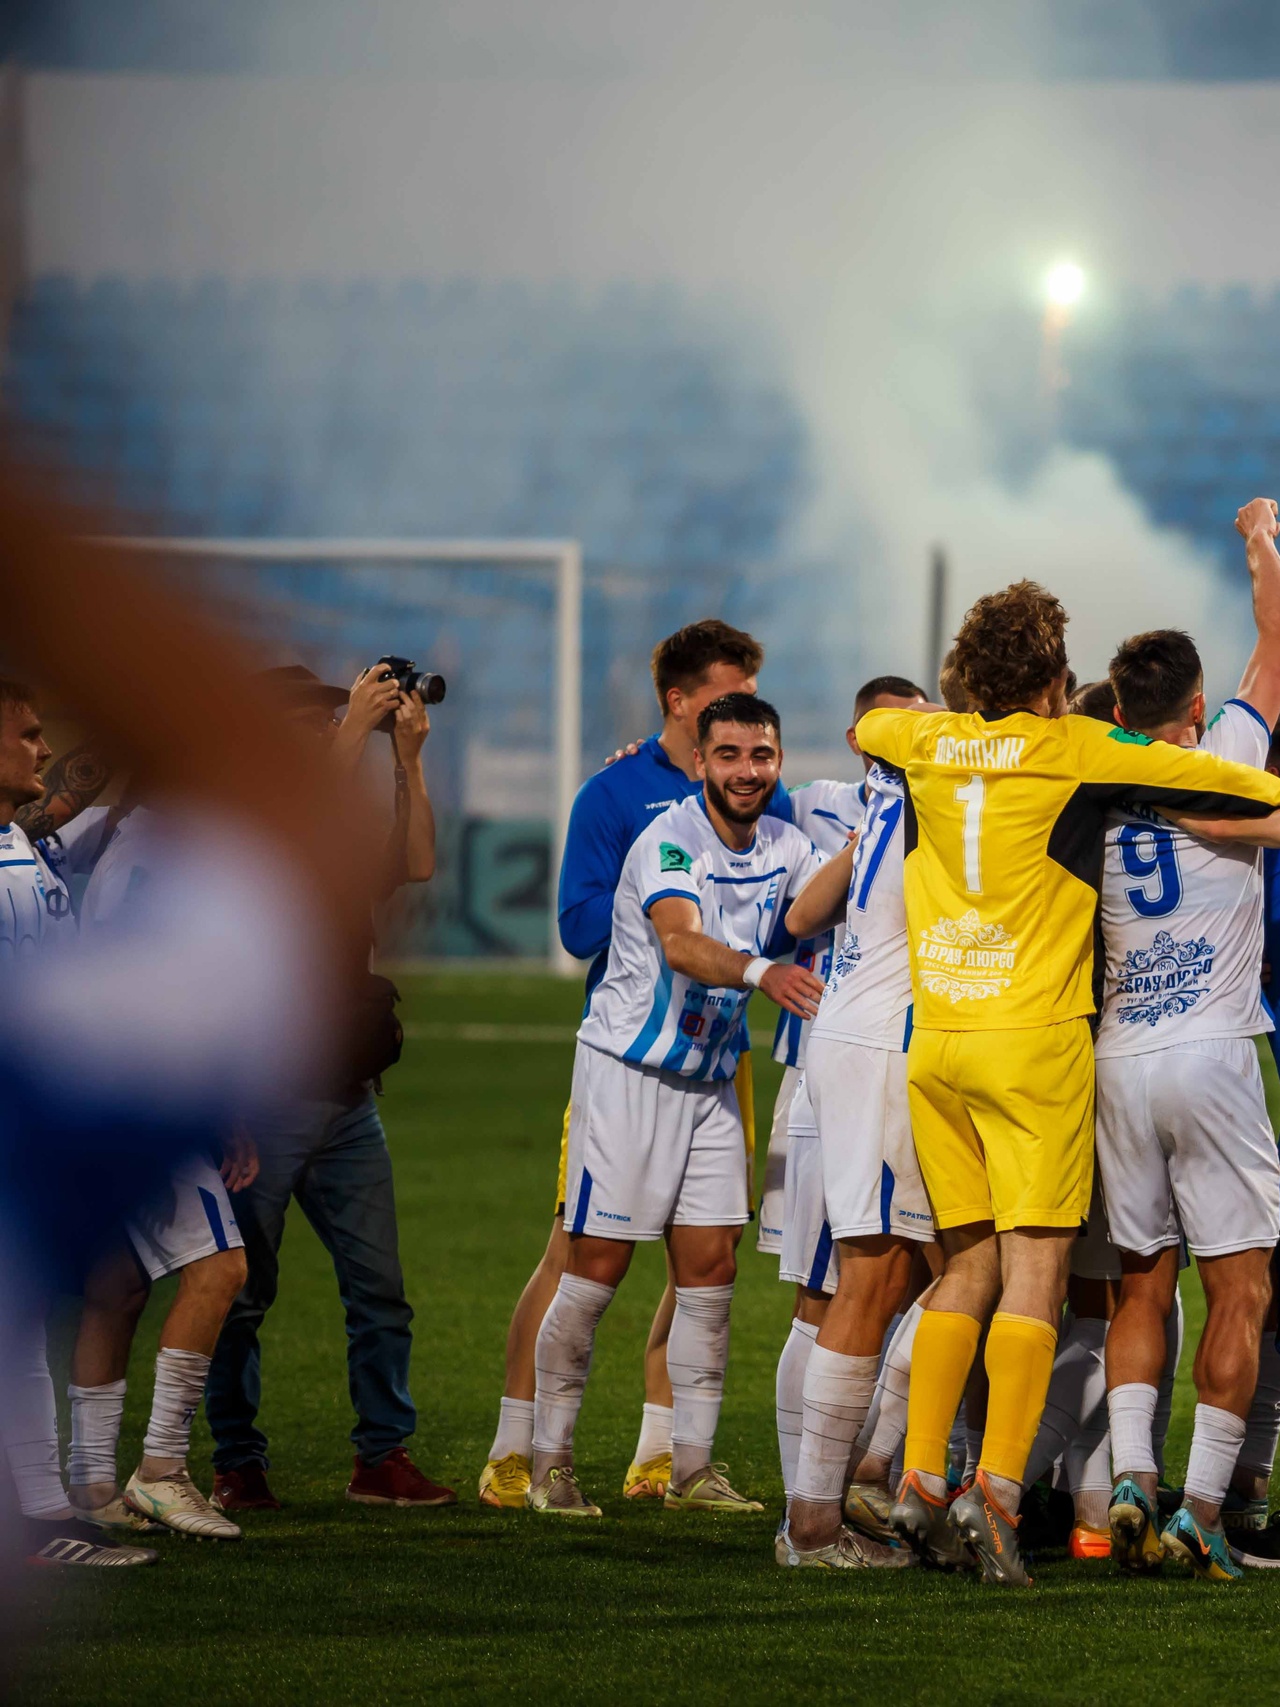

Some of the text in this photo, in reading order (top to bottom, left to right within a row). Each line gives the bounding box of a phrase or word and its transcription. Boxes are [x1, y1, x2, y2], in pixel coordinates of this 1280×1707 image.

[953, 772, 987, 895] 1
[1114, 820, 1183, 919] 9
[983, 1502, 1003, 1555] ULTRA
